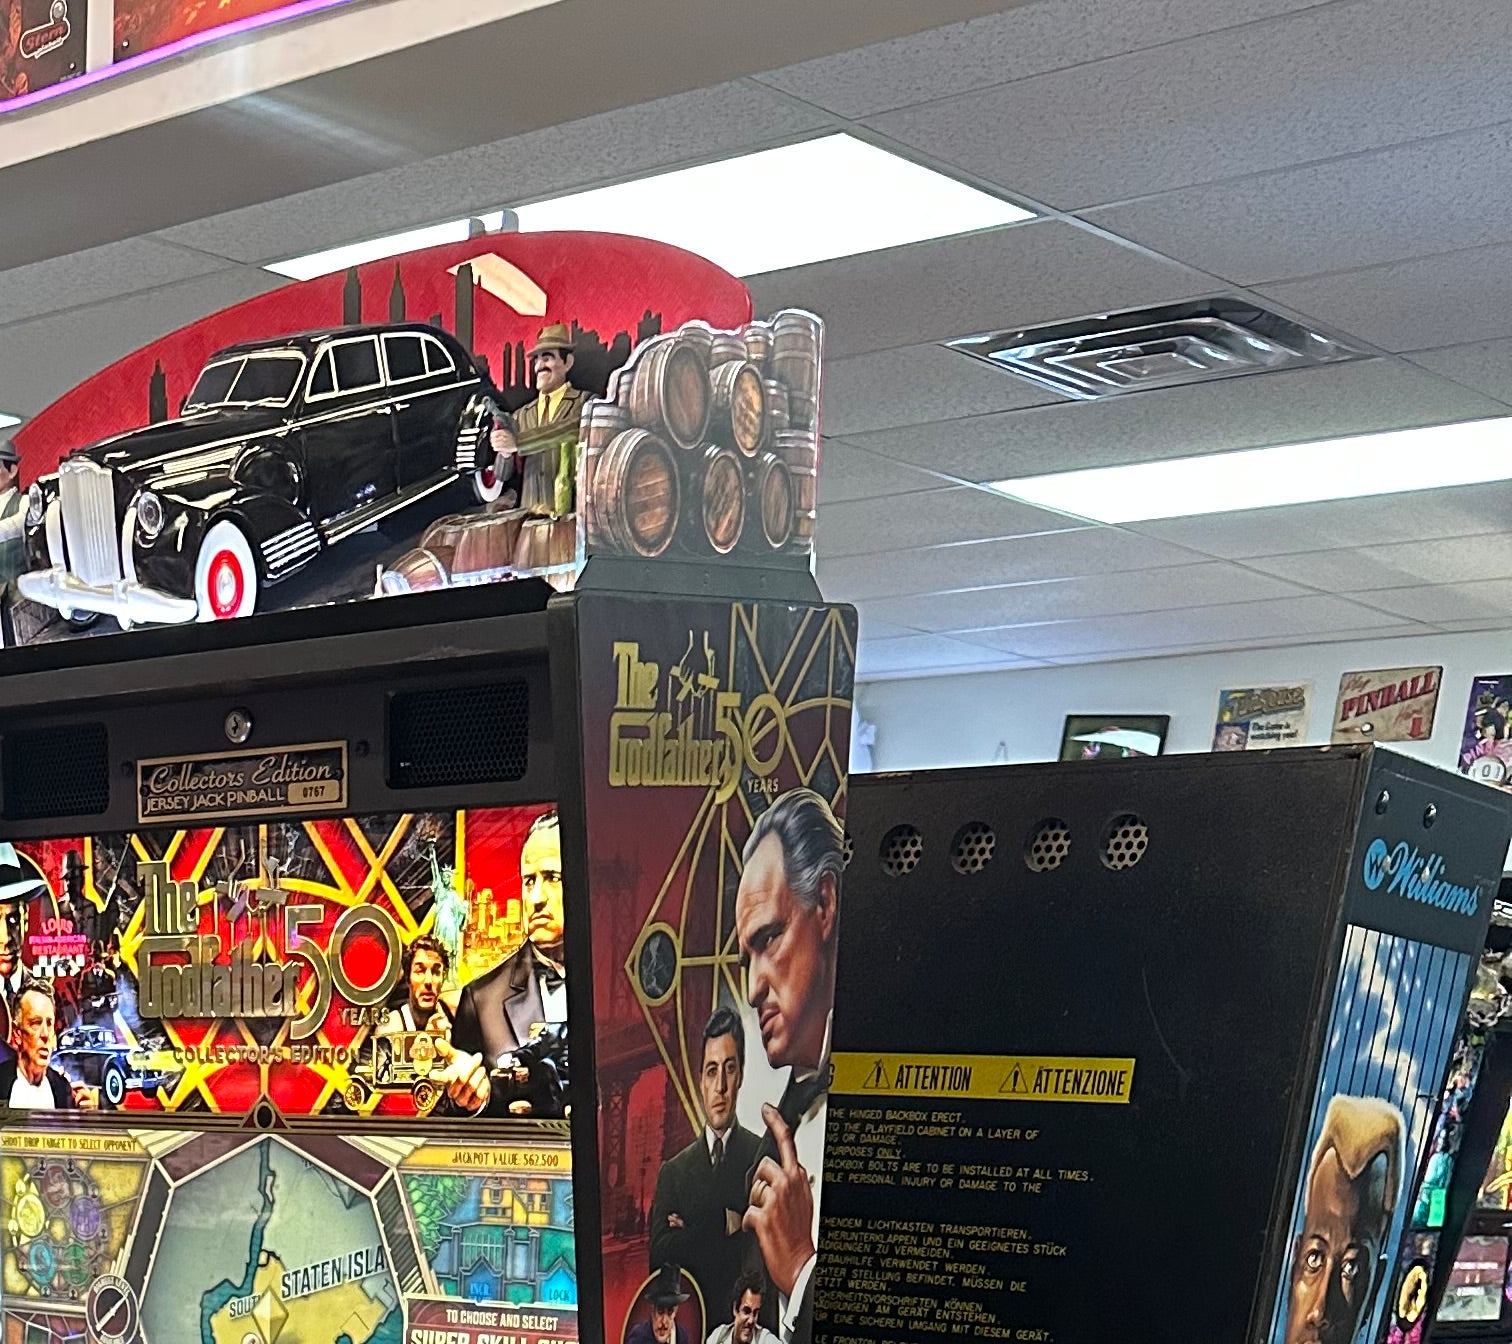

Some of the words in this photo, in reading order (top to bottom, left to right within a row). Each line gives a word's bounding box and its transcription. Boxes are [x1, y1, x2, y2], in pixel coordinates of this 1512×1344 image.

[612, 641, 659, 709] The
[1340, 671, 1436, 722] PINBALL
[609, 711, 730, 787] Godfather
[715, 691, 786, 806] 50
[150, 764, 244, 794] Collectors
[252, 754, 332, 785] Edition
[746, 777, 779, 794] YEARS
[144, 797, 190, 815] JERSEY
[190, 791, 225, 811] JACK
[227, 786, 285, 807] PINBALL
[1386, 840, 1479, 917] Williams
[137, 860, 200, 935] The
[137, 934, 305, 1020] Godfather
[284, 902, 403, 1041] 50
[339, 1007, 390, 1027] YEARS
[172, 1045, 282, 1065] COLLECTOR'S
[291, 1044, 361, 1065] EDITION
[894, 1063, 973, 1092] ATTENTION
[1033, 1067, 1129, 1097] ATTENZIONE
[828, 1108, 846, 1119] THE
[849, 1109, 883, 1120] HINGED
[885, 1110, 928, 1121] BACKBOX
[828, 1122, 840, 1132] TO
[844, 1123, 861, 1133] THE
[865, 1123, 915, 1136] PLAYFIELD
[916, 1125, 956, 1137] CABINET
[958, 1126, 972, 1137] ON
[976, 1127, 984, 1138] A
[988, 1128, 1021, 1140] LAYER
[1025, 1129, 1040, 1140] OF
[452, 1151, 490, 1165] JACKPOT
[868, 1160, 899, 1172] BOLTS
[902, 1162, 922, 1173] ARE
[926, 1162, 939, 1174] TO
[942, 1163, 955, 1175] BE
[960, 1165, 1013, 1178] INSTALLED
[1016, 1167, 1030, 1178] AT
[1033, 1168, 1053, 1180] ALL
[1058, 1169, 1094, 1182] TIMES.
[849, 1173, 896, 1186] PERSONAL
[901, 1176, 936, 1187] INJURY
[940, 1178, 954, 1189] OR
[959, 1179, 999, 1192] DAMAGE
[1003, 1181, 1017, 1193] TO
[1022, 1182, 1043, 1194] THE
[867, 1219, 935, 1233] LICHTKASTEN
[940, 1223, 1032, 1240] TRANSPORTIEREN.
[281, 1256, 342, 1299] STATEN
[348, 1245, 389, 1280] ISLA
[548, 1288, 570, 1302] LOCK
[446, 1309, 457, 1323] TO
[460, 1311, 498, 1326] CHOOSE
[499, 1313, 520, 1328] AND
[522, 1315, 559, 1331] SELECT
